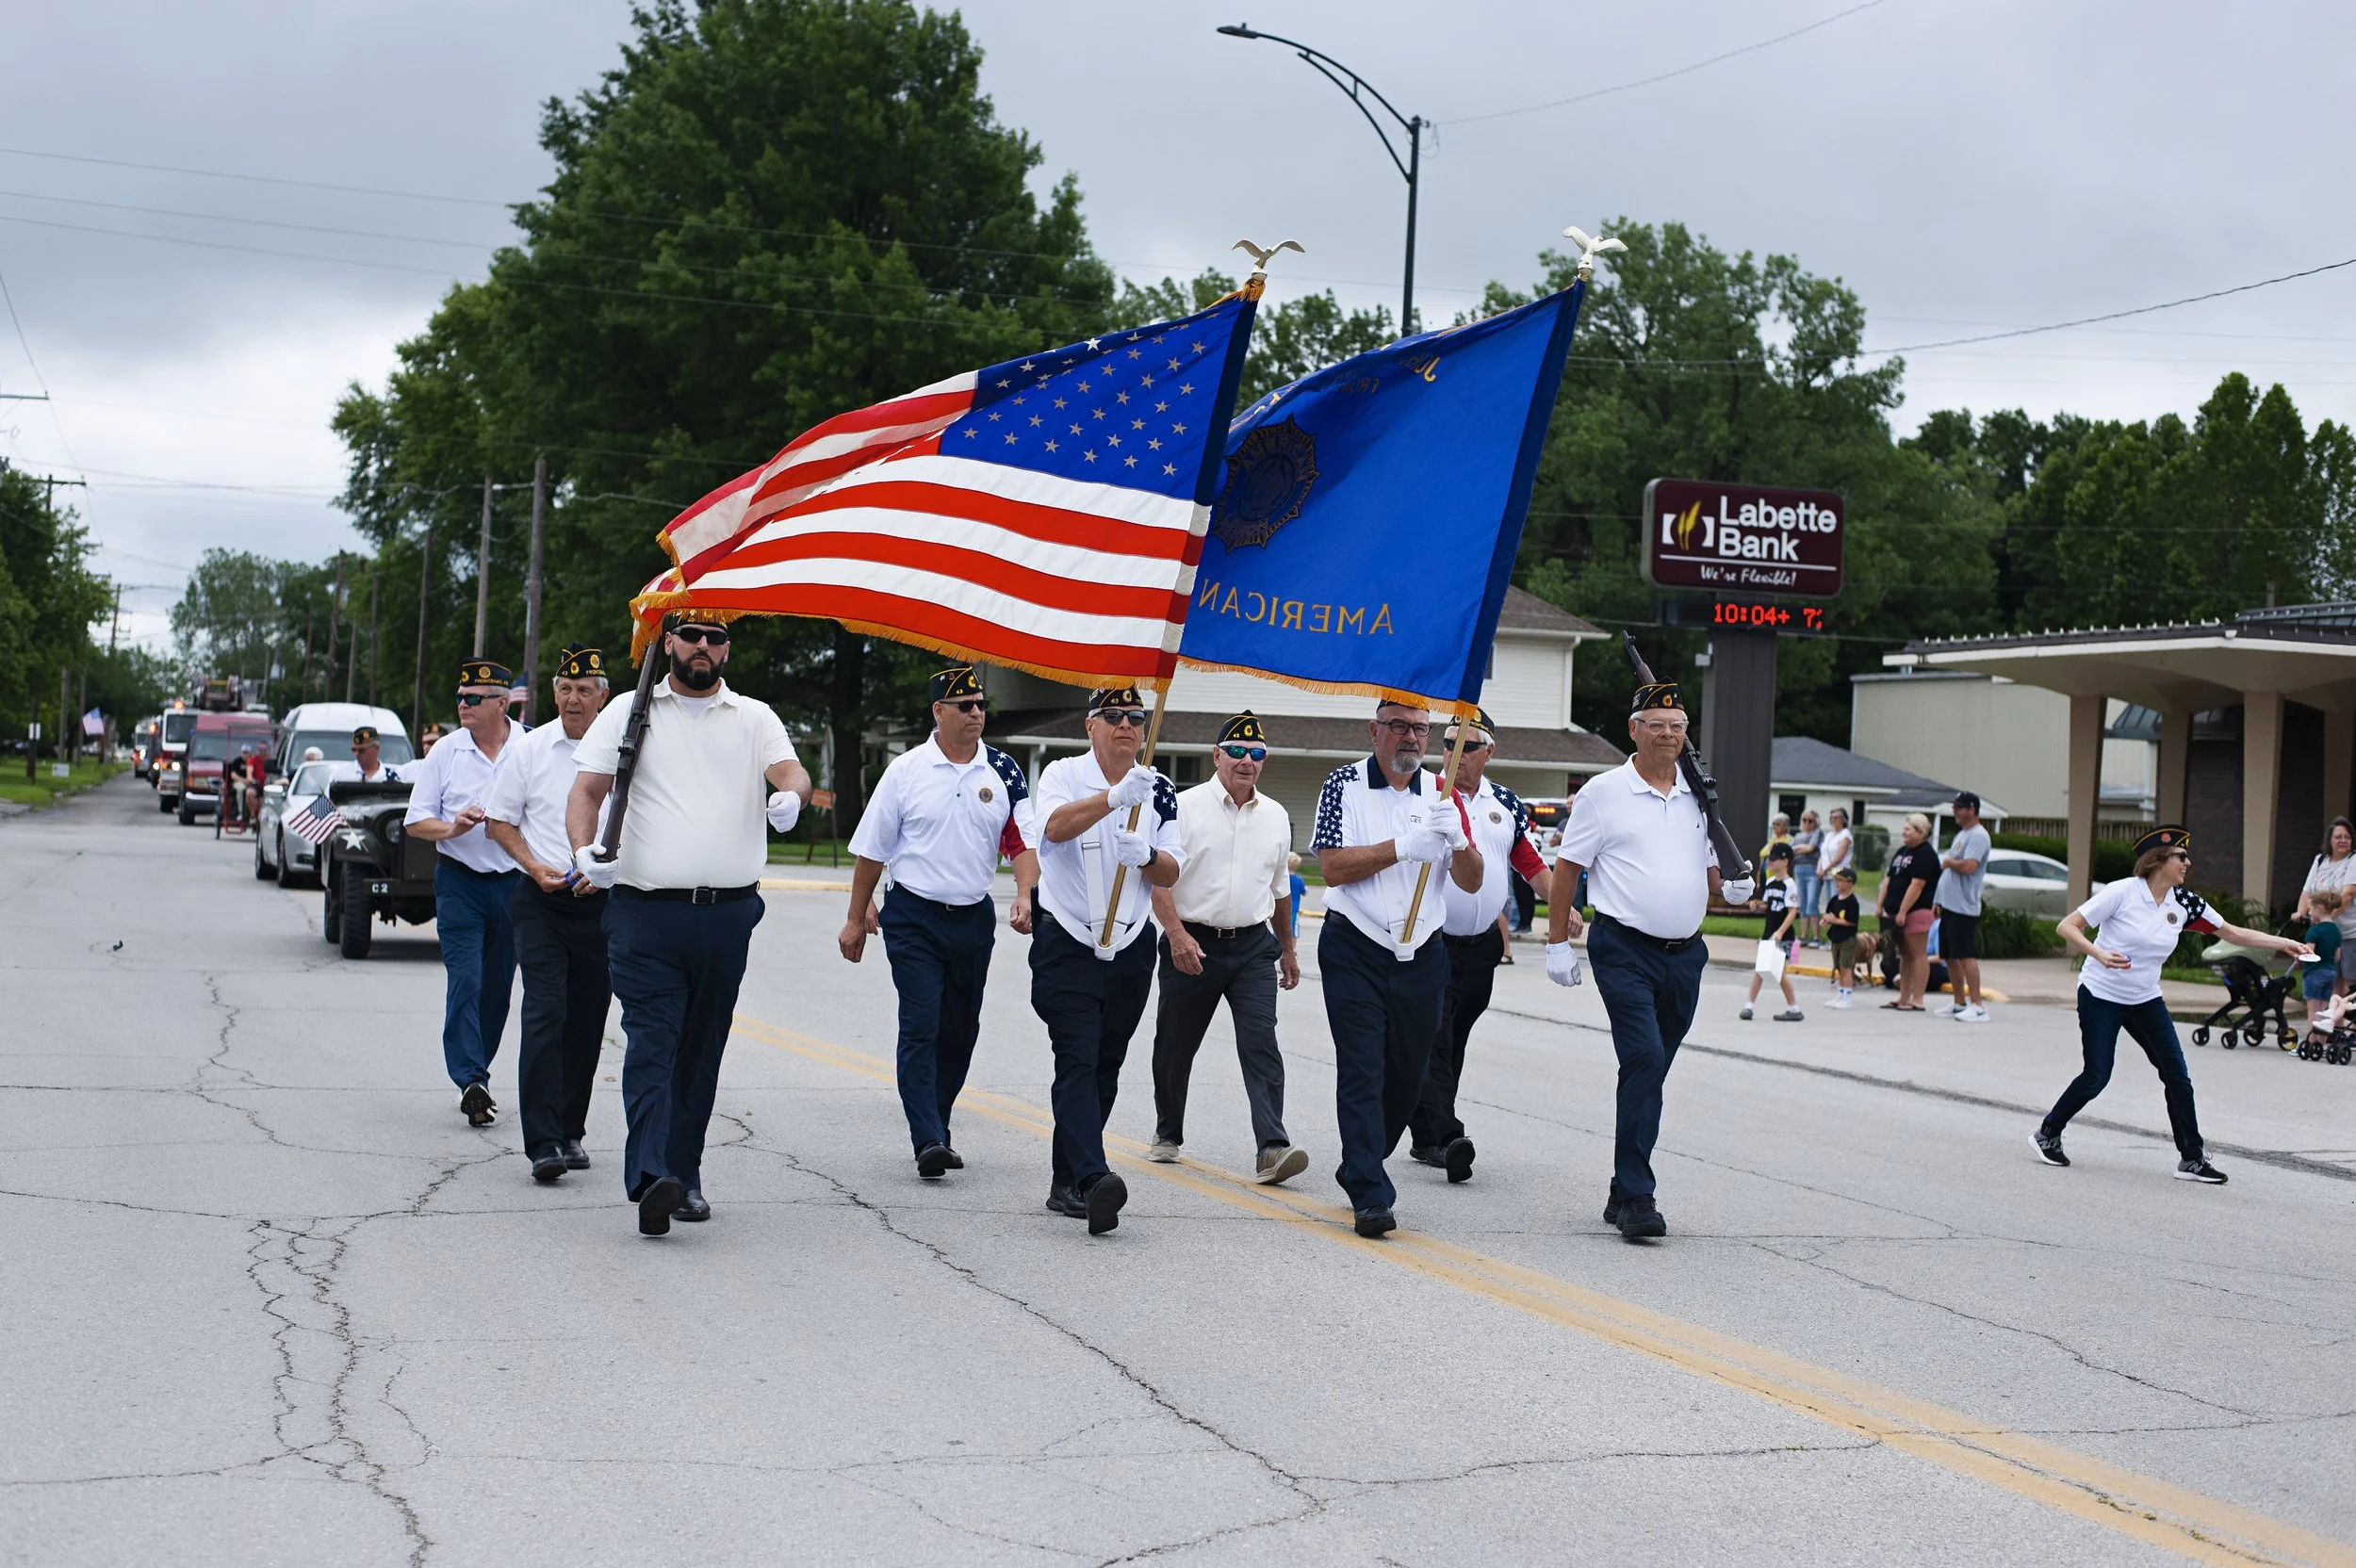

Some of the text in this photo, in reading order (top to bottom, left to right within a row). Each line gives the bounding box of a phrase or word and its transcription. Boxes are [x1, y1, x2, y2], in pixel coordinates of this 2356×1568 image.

[1720, 495, 1837, 533] Labette
[1719, 527, 1801, 562] Bank
[1700, 564, 1797, 587] We're Flexible!
